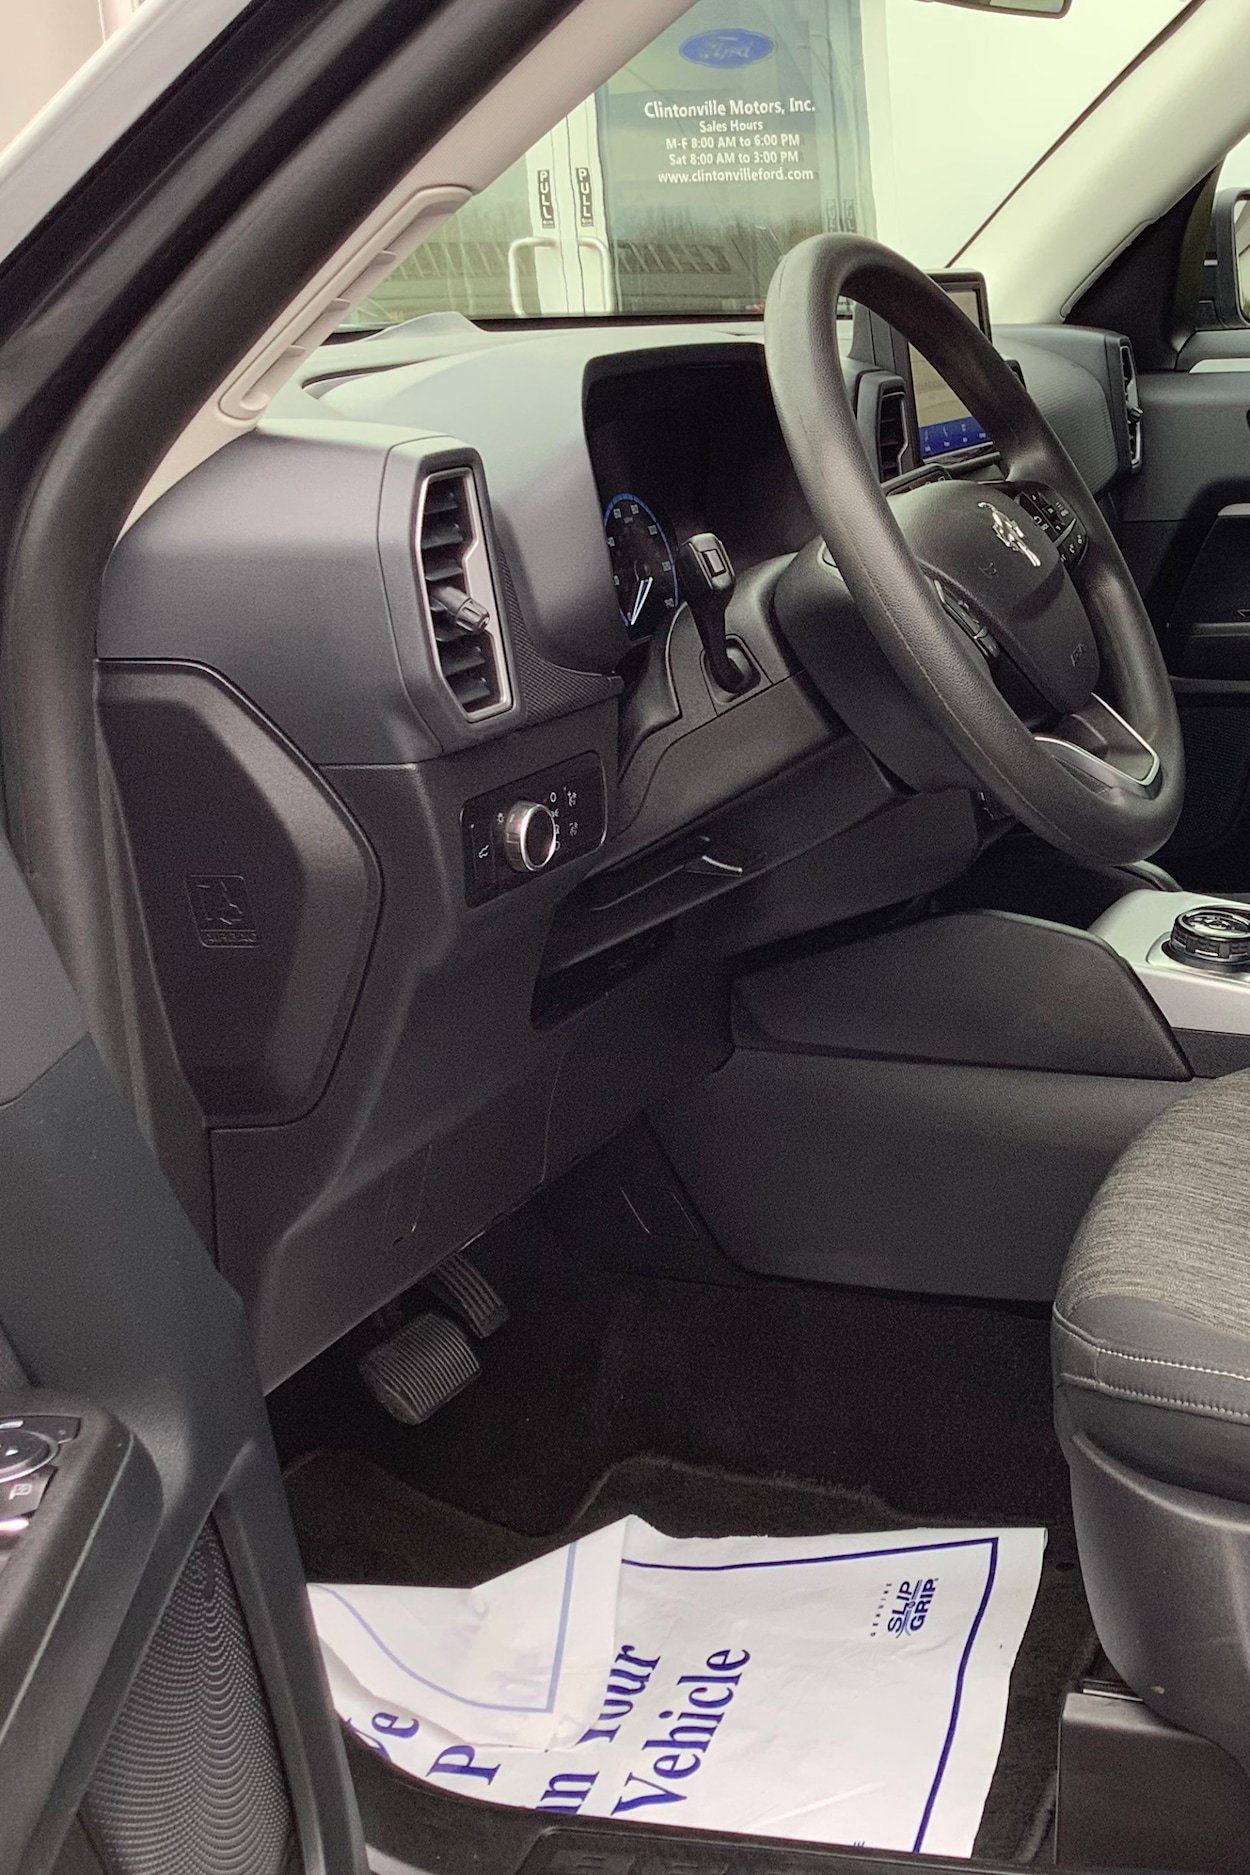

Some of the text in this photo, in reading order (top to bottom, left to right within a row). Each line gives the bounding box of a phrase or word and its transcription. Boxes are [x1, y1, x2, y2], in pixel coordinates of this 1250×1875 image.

[644, 97, 816, 118] Clintonville Motors, Inc.
[665, 134, 800, 149] M-F 8:00 AM to 6:00 PM
[699, 119, 763, 133] Sales Hours
[658, 167, 814, 183] www.clintonvilleford.com
[669, 151, 799, 166] Sat 8:00 AM to 3:00 PM
[540, 171, 552, 219] PULL
[578, 168, 591, 217] PULL
[887, 1581, 912, 1633] SLIP
[910, 1578, 936, 1631] GRIP
[611, 1649, 750, 1816] Vehicle
